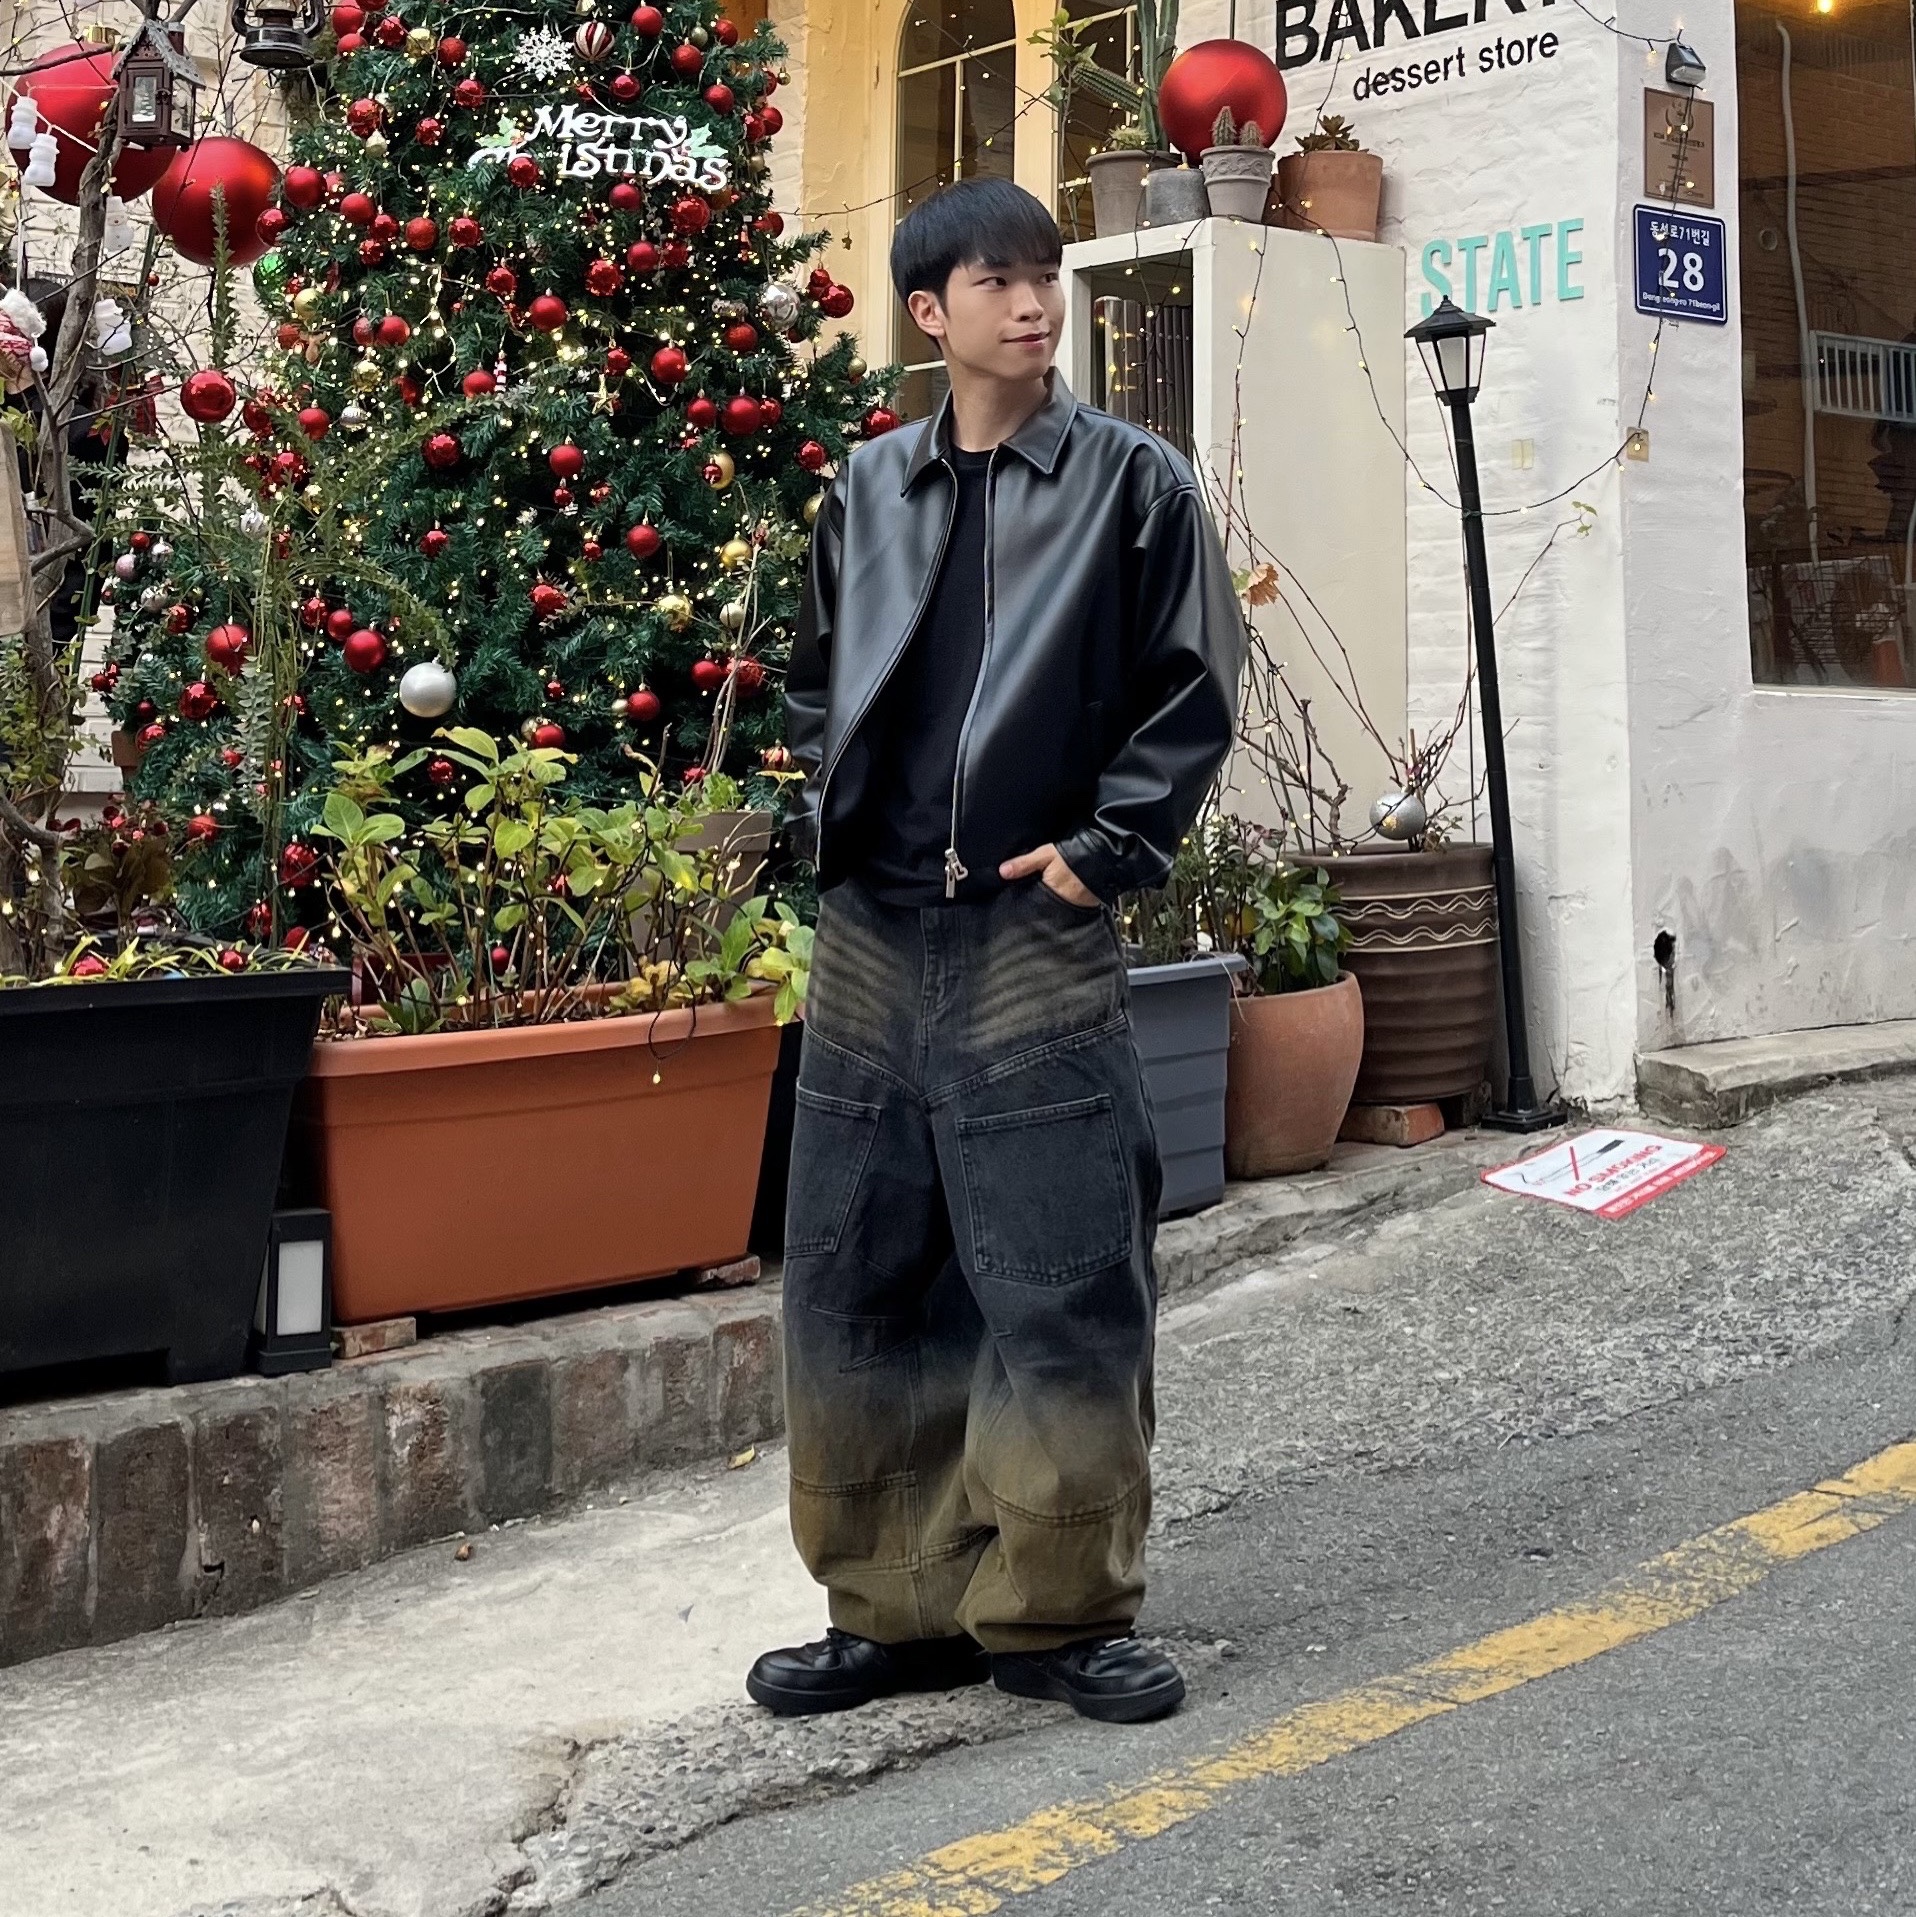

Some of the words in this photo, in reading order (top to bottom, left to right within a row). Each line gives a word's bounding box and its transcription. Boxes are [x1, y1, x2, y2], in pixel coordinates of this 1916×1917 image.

[1275, 0, 1558, 71] BAK
[1353, 46, 1466, 101] dessert
[1478, 32, 1560, 74] store
[525, 103, 688, 150] Merry
[1420, 218, 1584, 319] STATE
[1658, 248, 1705, 292] 28
[1563, 1182, 1592, 1197] NO
[1588, 1144, 1662, 1183] SMOKING
